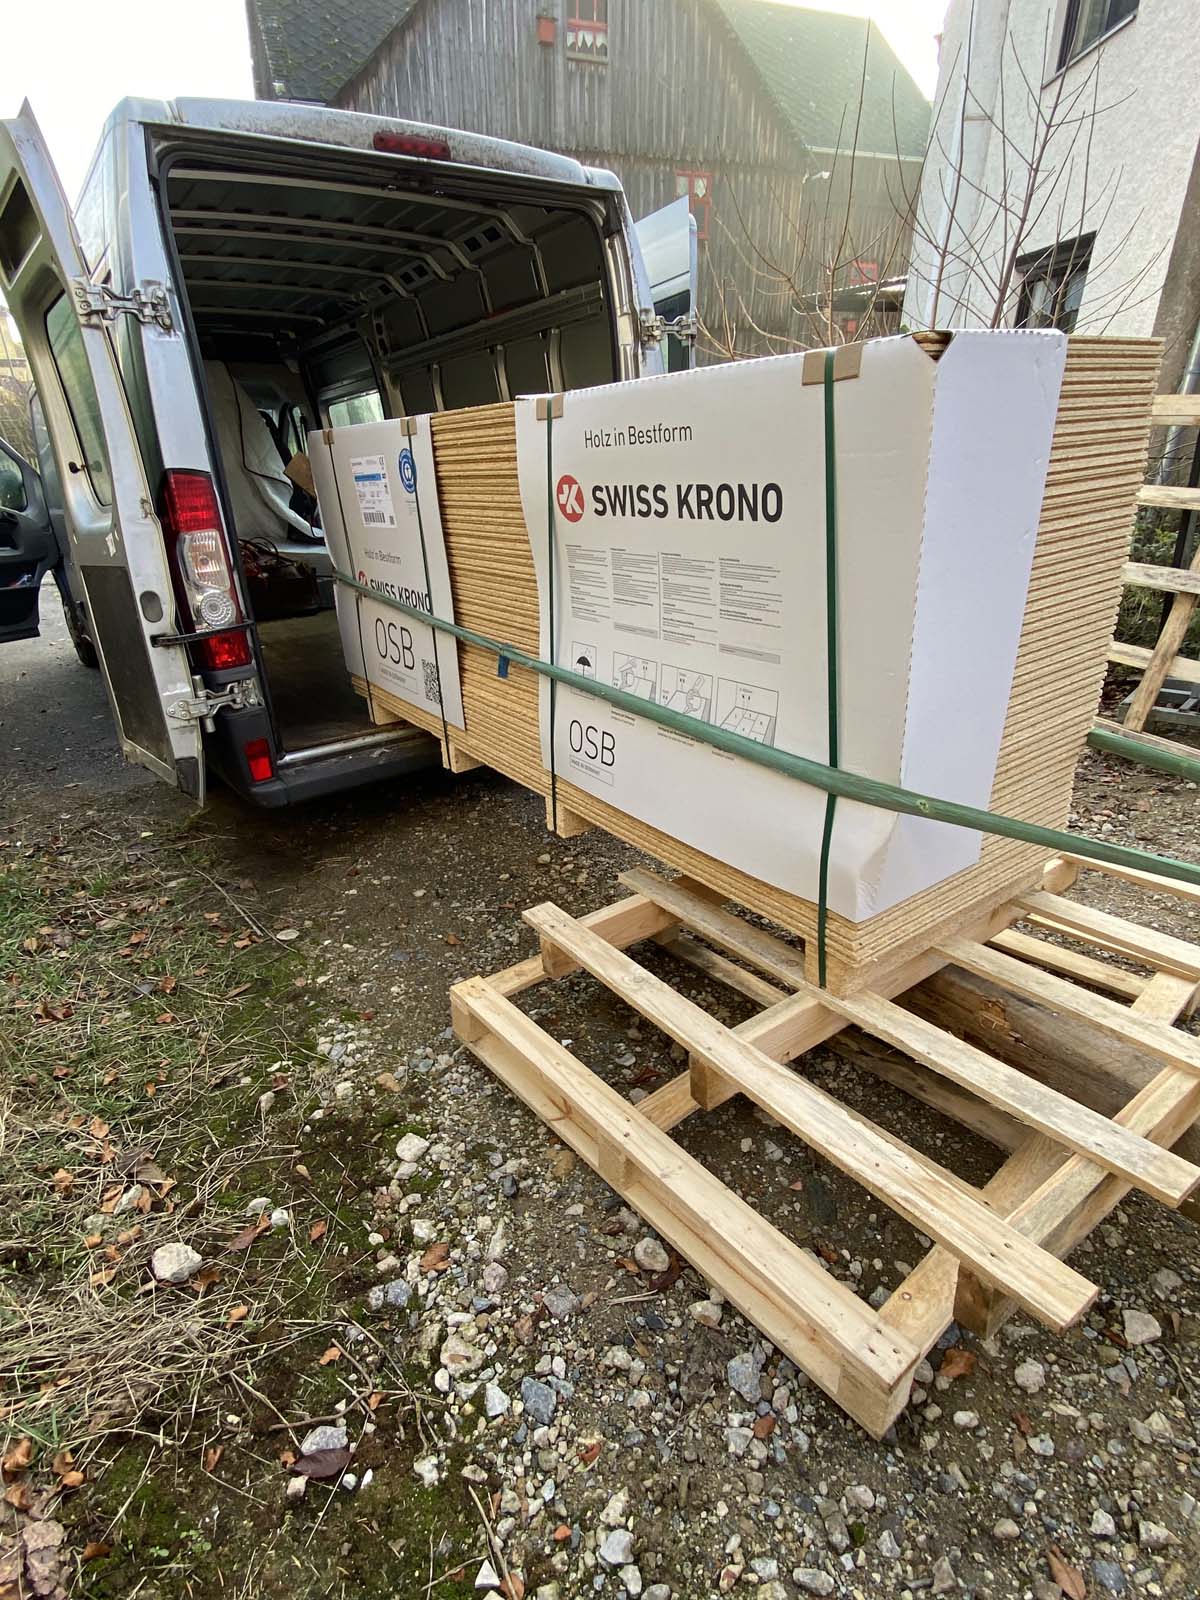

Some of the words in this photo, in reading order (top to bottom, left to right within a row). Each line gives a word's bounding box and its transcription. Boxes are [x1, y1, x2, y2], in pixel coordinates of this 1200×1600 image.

[584, 429, 612, 449] Holz
[614, 427, 626, 446] in
[628, 423, 693, 445] Bestform
[591, 483, 669, 519] SWISS
[676, 482, 783, 523] KRONO
[375, 617, 415, 670] OSB
[569, 719, 615, 766] OSB
